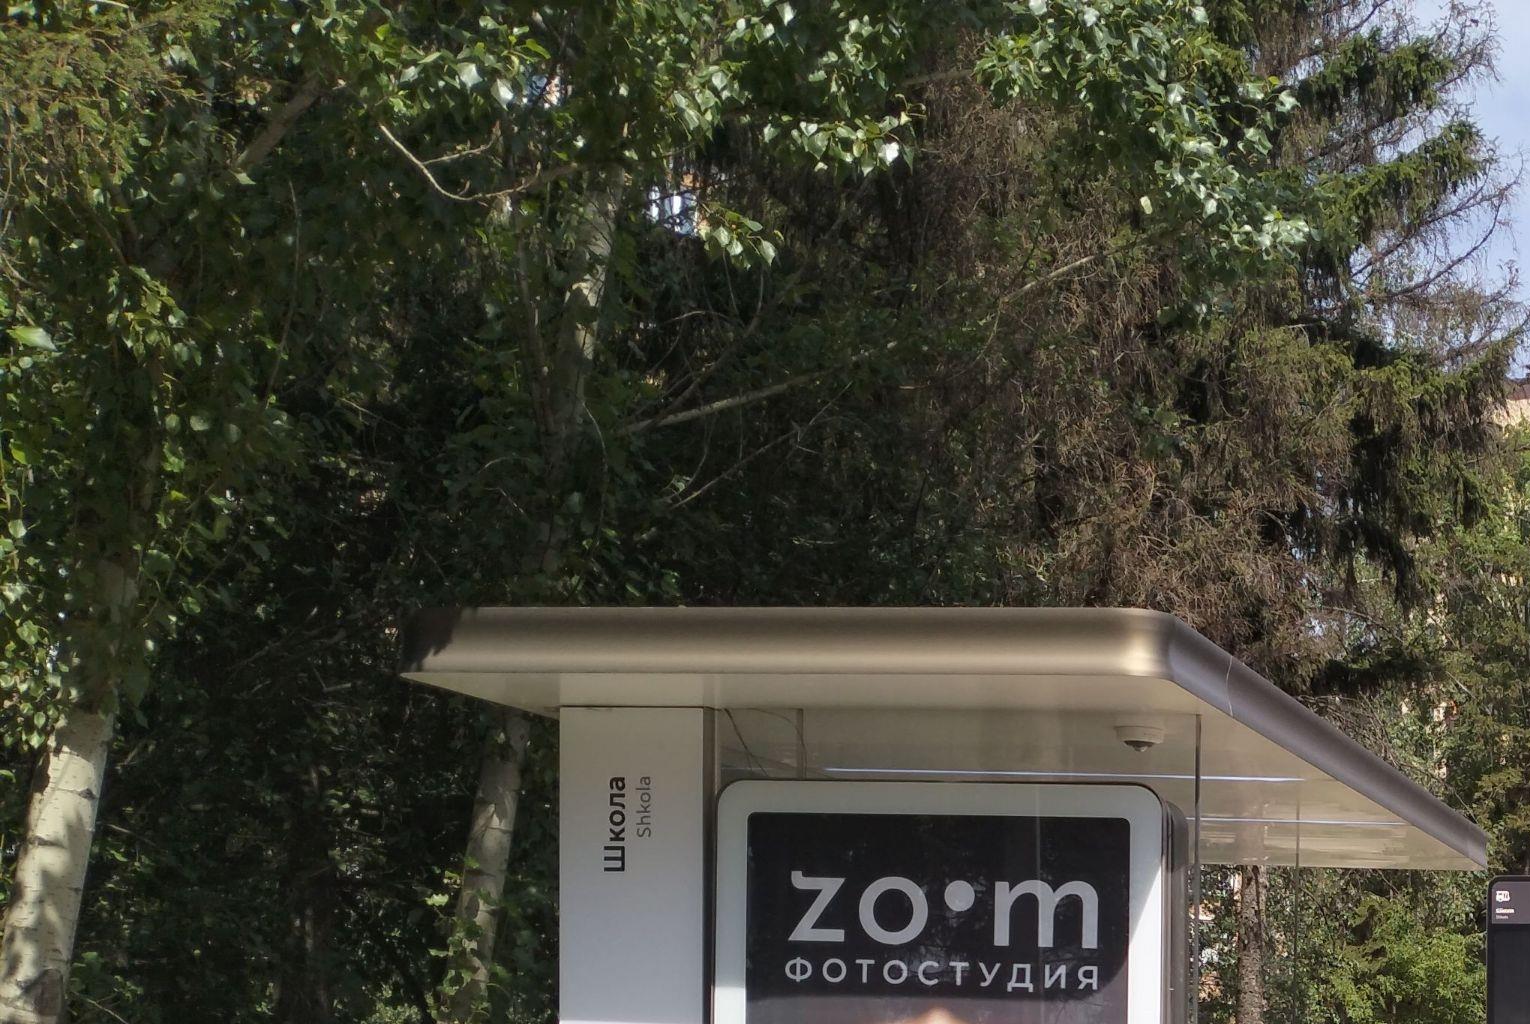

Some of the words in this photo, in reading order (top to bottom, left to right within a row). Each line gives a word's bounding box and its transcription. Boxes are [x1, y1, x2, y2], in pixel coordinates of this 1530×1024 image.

[603, 776, 626, 872] Школа
[635, 776, 651, 838] Shkola
[784, 956, 1099, 993] ФОТОСТУДИЯ
